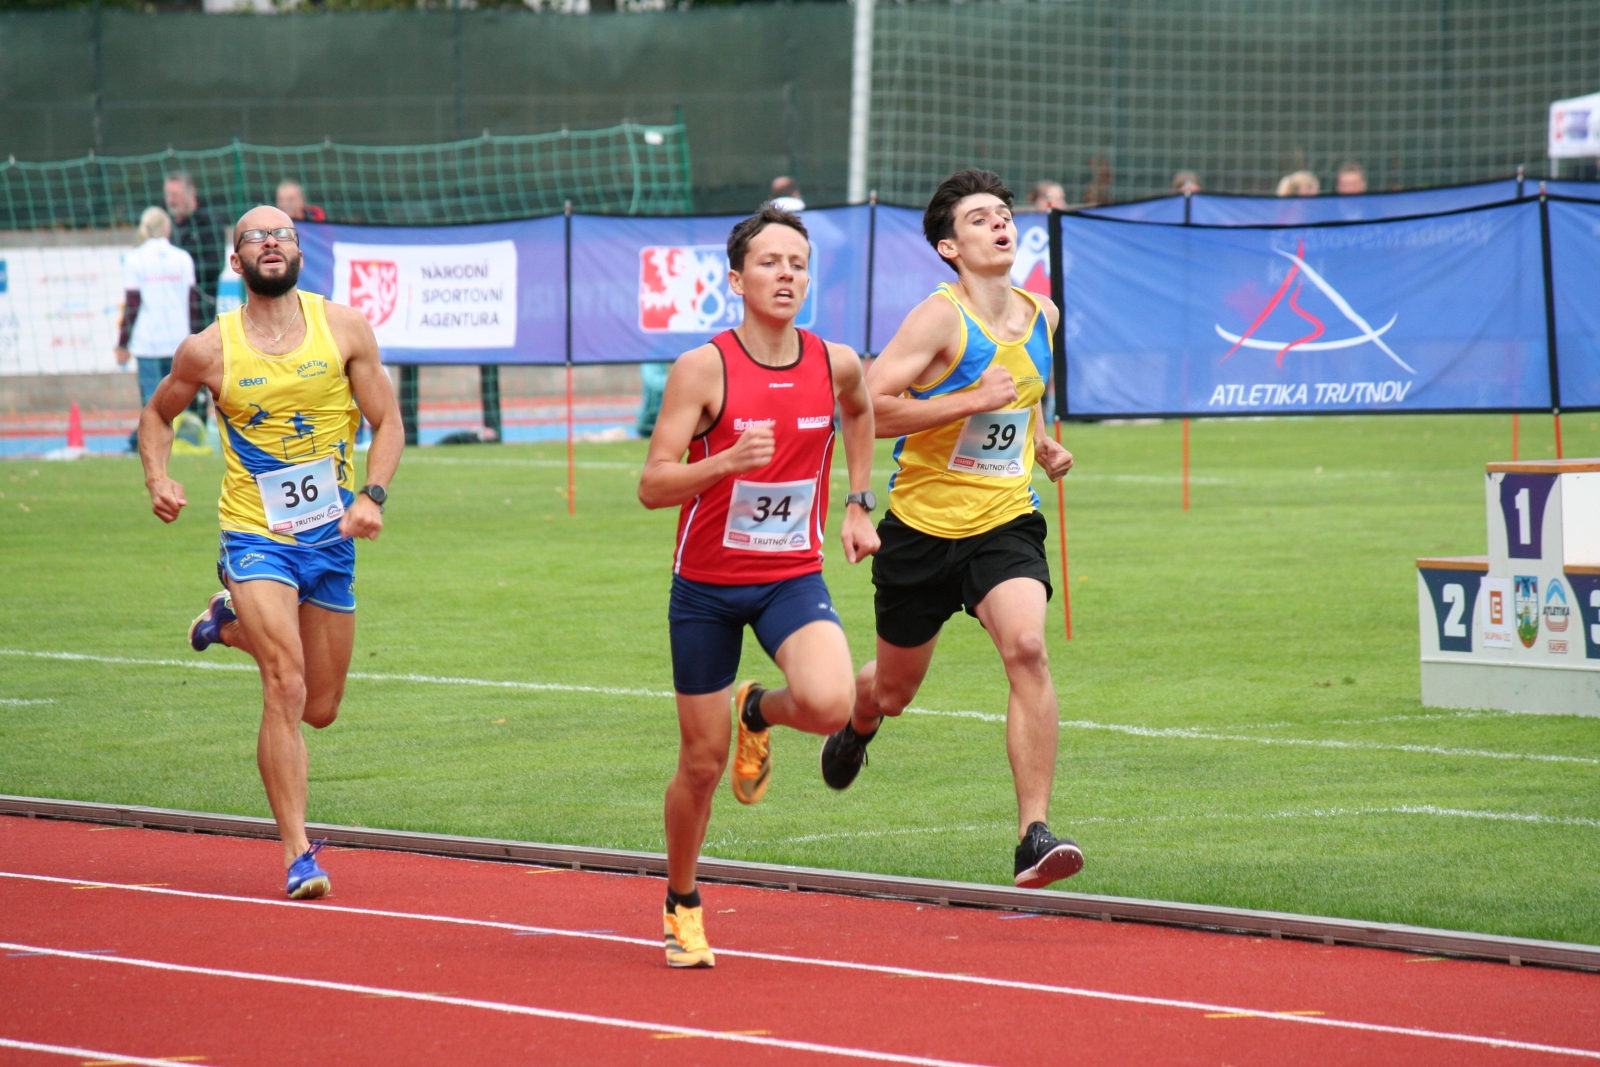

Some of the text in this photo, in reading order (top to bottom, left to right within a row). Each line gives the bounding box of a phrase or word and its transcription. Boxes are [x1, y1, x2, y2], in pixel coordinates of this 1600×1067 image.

[422, 282, 503, 303] SPORTOVNÍ
[420, 312, 499, 327] AGENTURA
[296, 360, 328, 375] ATLETIKA
[239, 377, 267, 387] eleven
[1209, 380, 1411, 406] ATLETIKA TRUTNOV
[981, 423, 1017, 451] 39
[976, 462, 1006, 471] TRUTNOV
[281, 474, 318, 508] 36
[752, 495, 792, 522] 34
[1514, 488, 1531, 545] 1
[295, 512, 325, 527] TRUTNOV
[753, 537, 788, 546] TRUTNOV
[1442, 583, 1466, 637] 2
[1543, 606, 1570, 616] ATLETIKA
